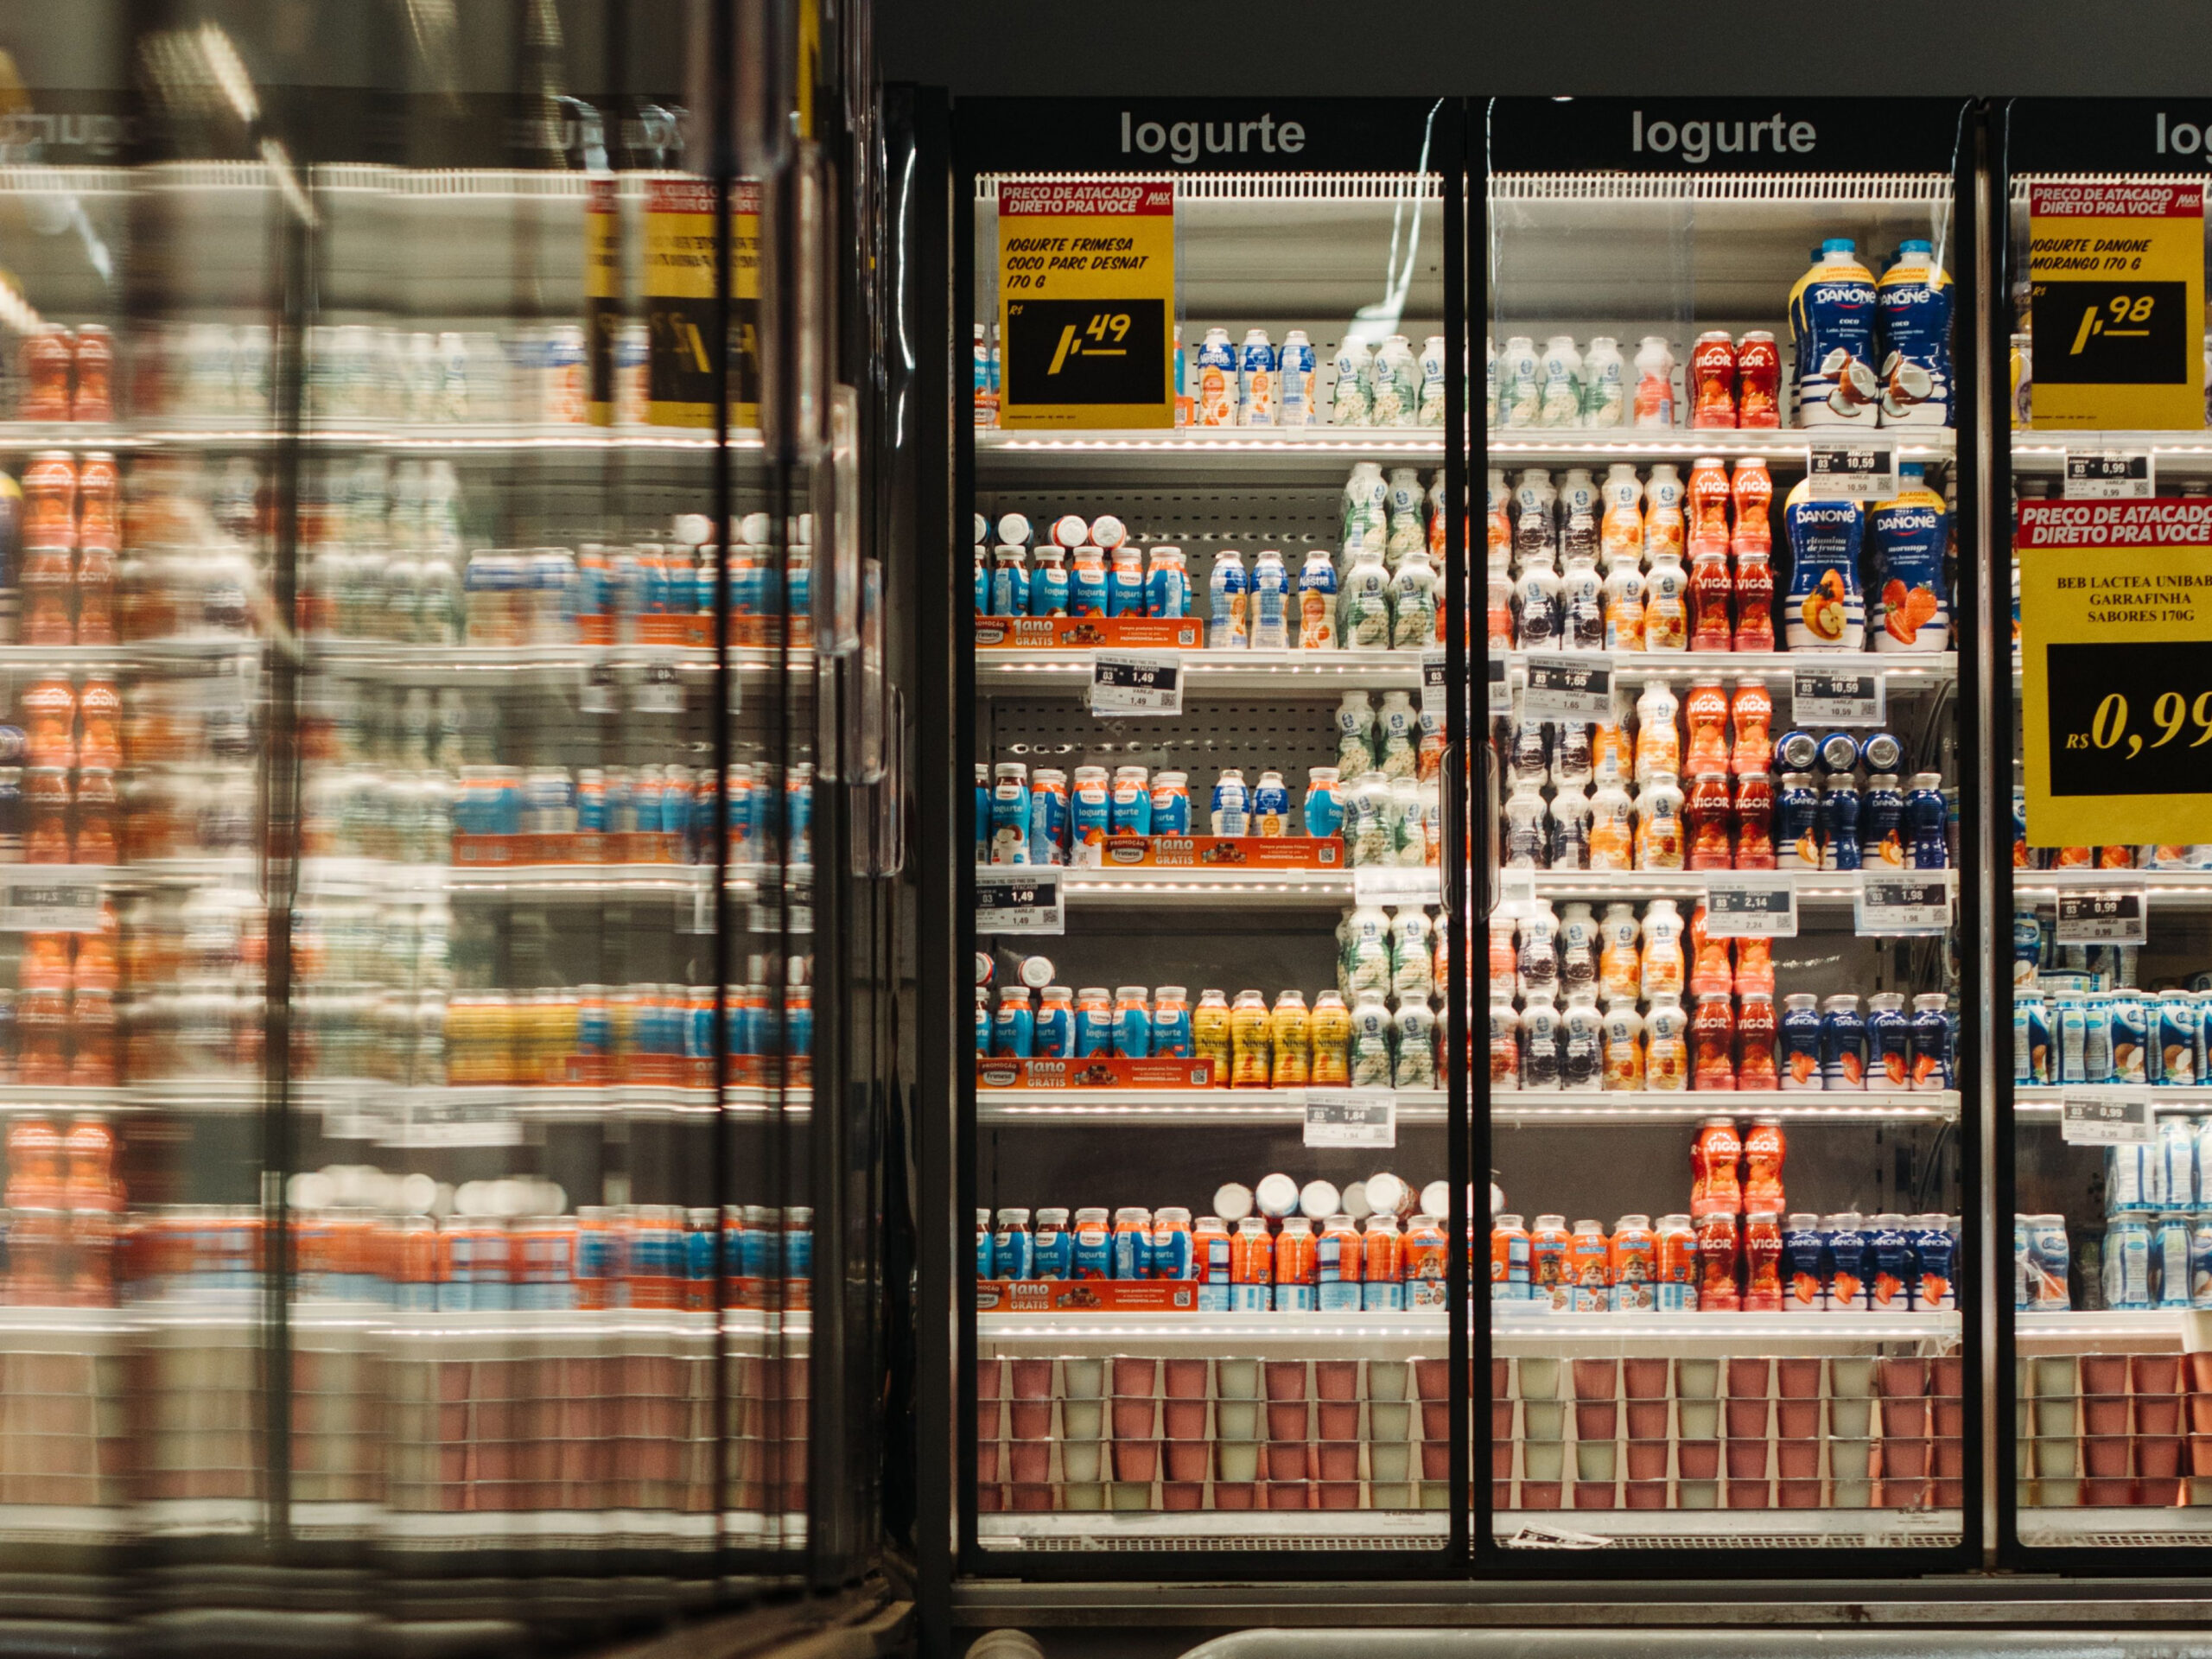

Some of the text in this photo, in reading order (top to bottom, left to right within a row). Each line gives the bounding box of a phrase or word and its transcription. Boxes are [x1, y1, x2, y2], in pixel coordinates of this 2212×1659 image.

[1121, 111, 1306, 164] Iogurte
[1632, 111, 1817, 163] Iogurte
[2156, 112, 2212, 163] Io
[1002, 187, 1143, 202] PREÇO DE ATACADO
[1146, 192, 1171, 205] MAX
[2032, 188, 2173, 202] PREÇO DE ATACADO
[2176, 194, 2200, 207] MAX
[1009, 200, 1062, 213] DIRETO
[1065, 200, 1096, 213] PRA
[2040, 201, 2094, 214] DIRETO
[2095, 201, 2126, 214] PRA
[1006, 238, 1134, 251] IOGURTE FRIMESA
[2031, 238, 2152, 252] IOGURTE DANONE
[1007, 256, 1149, 270] COCO PARC DESNAT
[2031, 257, 2141, 270] MORANGO 170 G
[1007, 276, 1046, 289] 170 G
[2032, 286, 2046, 296] R$
[1008, 305, 1023, 315] R$
[1738, 355, 1764, 367] GOR
[1847, 457, 1875, 469] 10,59
[2102, 462, 2126, 474] 0,99
[2022, 506, 2090, 527] PREÇO
[2092, 505, 2120, 524] DE
[2031, 519, 2210, 544] DIRETO PRA VOCÊ
[1738, 578, 1773, 590] VIGOR
[2056, 576, 2086, 588] BEB
[2090, 576, 2152, 588] LACTEA
[2089, 592, 2191, 606] GARRAFINHA
[2088, 609, 2195, 622] SABORES 170G
[1132, 671, 1154, 683] 1,49
[1564, 675, 1587, 687] 1,65
[1830, 682, 1859, 693] 10,59
[1690, 701, 1726, 713] VIGOR
[1736, 701, 1771, 713] VIGOR
[2065, 732, 2089, 750] R$
[1692, 797, 1730, 809] VIGOR
[1114, 808, 1140, 819] ogurte
[1011, 891, 1034, 902] 1,49
[1901, 890, 1923, 901] 1,98
[1745, 897, 1768, 908] 2,14
[2094, 902, 2117, 913] 0,99
